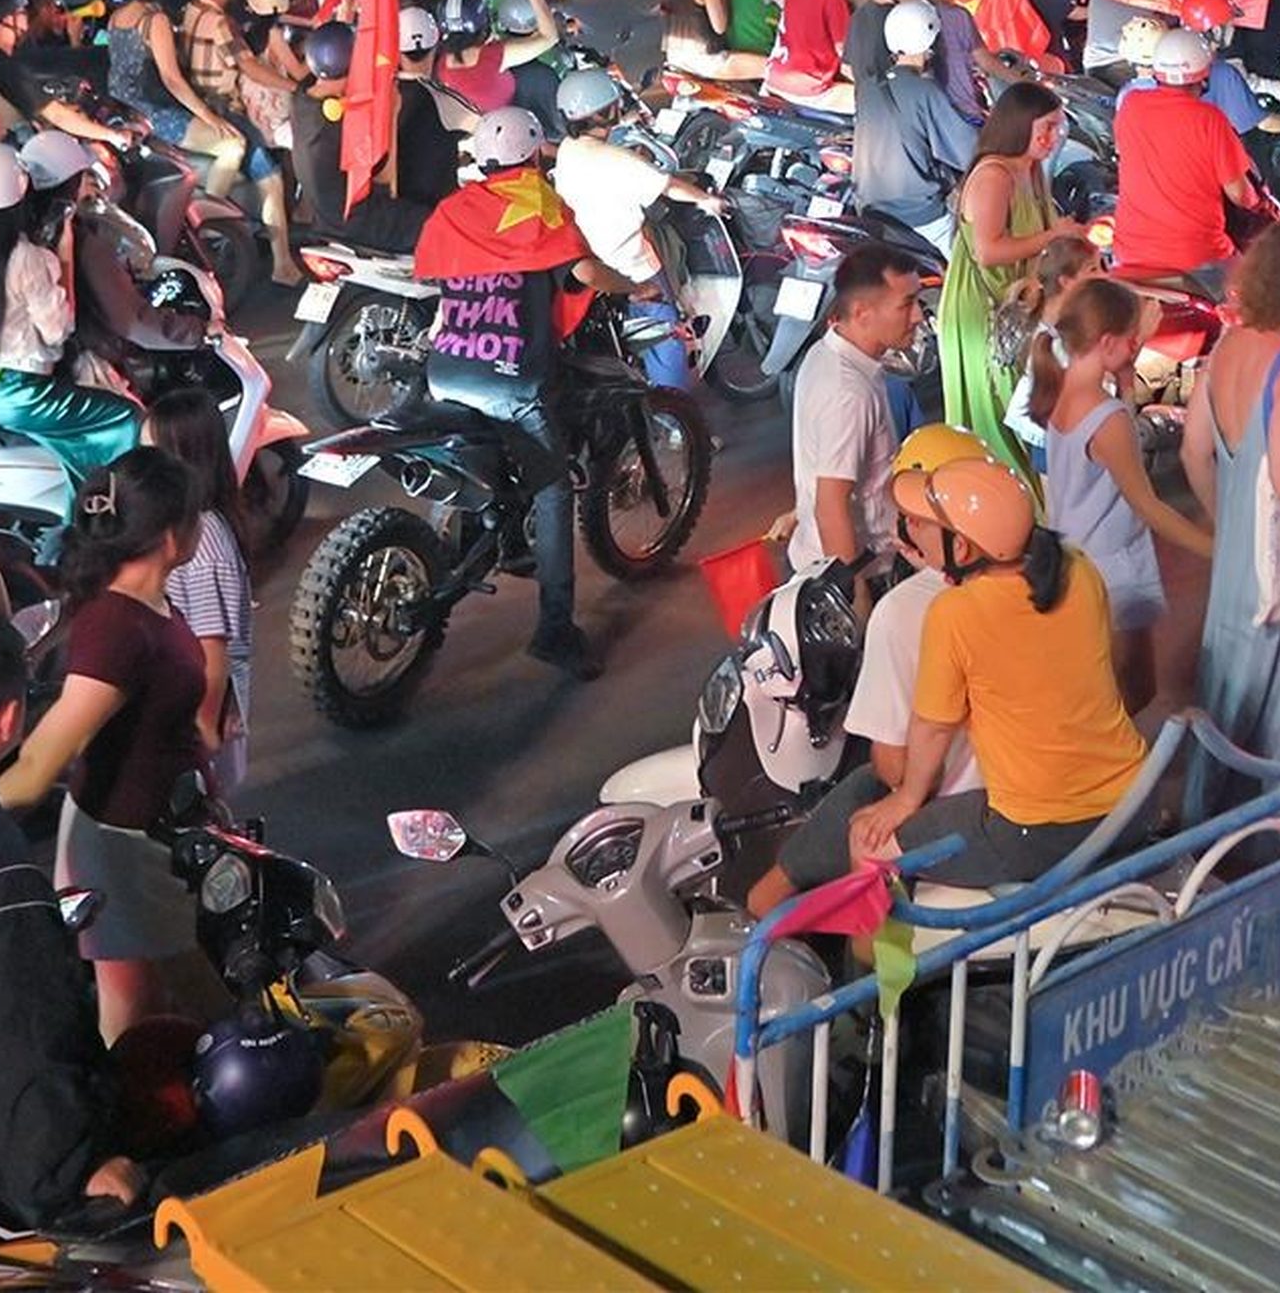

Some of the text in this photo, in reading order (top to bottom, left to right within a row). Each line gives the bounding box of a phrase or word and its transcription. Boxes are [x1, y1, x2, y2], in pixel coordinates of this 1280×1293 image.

[1063, 906, 1254, 1061] KHU VỰC CẤ
